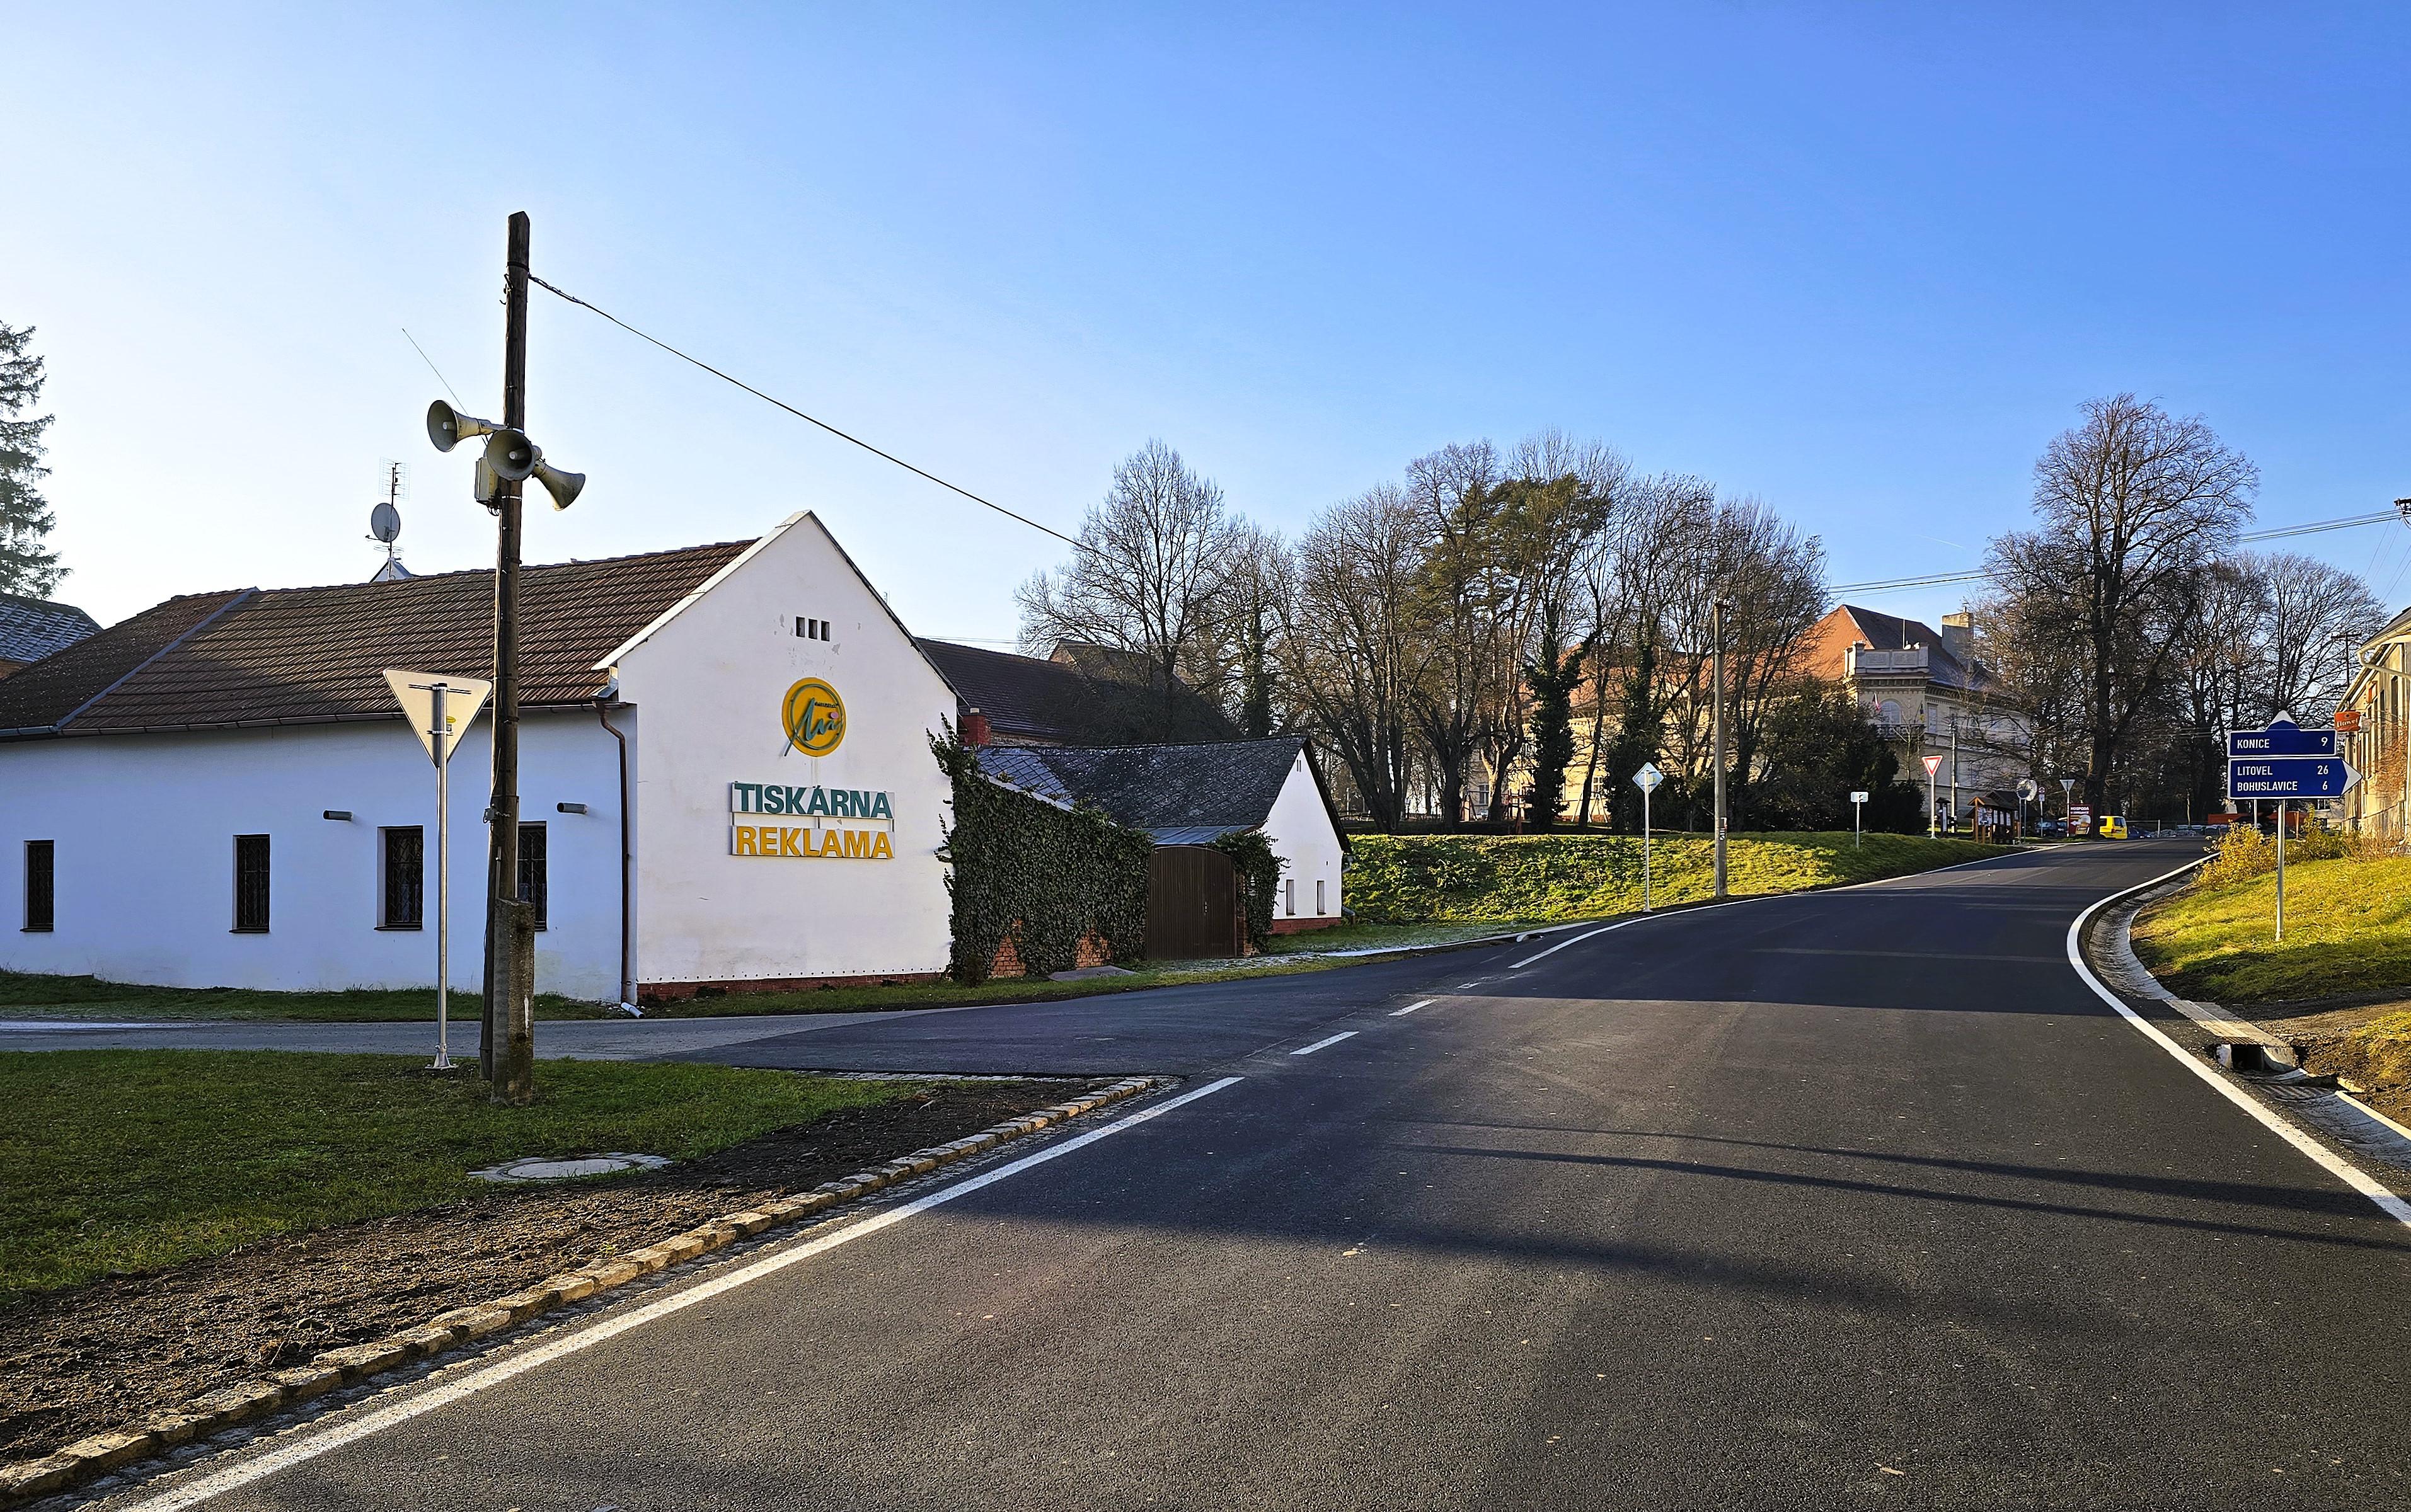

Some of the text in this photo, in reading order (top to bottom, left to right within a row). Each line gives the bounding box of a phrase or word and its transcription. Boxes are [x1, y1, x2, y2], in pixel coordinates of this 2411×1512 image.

[2237, 736, 2328, 749] KONICE 9
[2237, 765, 2329, 776] LITOVEL 26
[2237, 781, 2328, 791] BOHUSLAVICE 6
[734, 783, 894, 819] TISKÁRNA
[736, 826, 894, 857] REKLAMA
